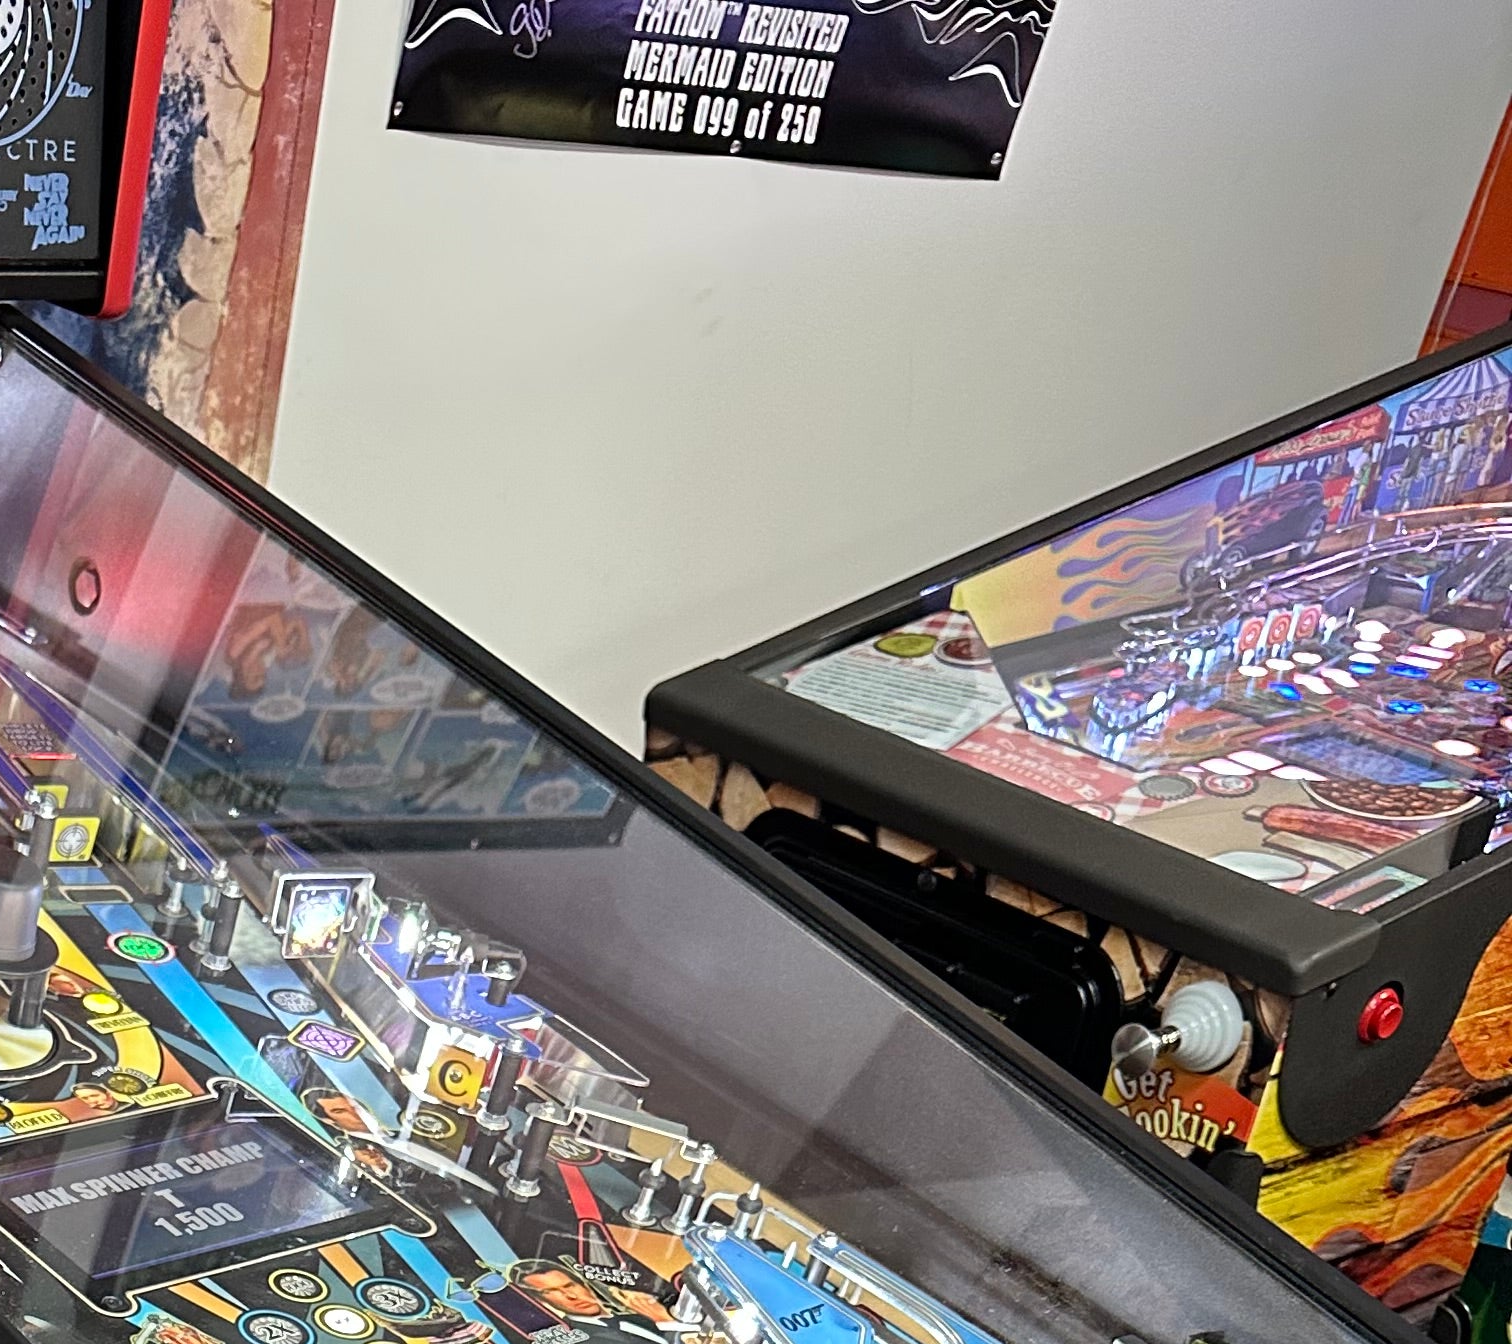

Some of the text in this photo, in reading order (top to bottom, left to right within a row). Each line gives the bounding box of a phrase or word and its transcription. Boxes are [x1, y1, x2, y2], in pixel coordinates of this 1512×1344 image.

[739, 4, 849, 53] REVISITED
[624, 40, 834, 98] MERMAID EDITION
[616, 88, 821, 144] GAME 099 of 250
[1118, 1098, 1236, 1153] ookin'
[10, 1142, 263, 1214] MAX SPINNER CHAMP
[154, 1188, 184, 1208] T
[155, 1202, 244, 1236] 1,500
[779, 1304, 826, 1332] 007
